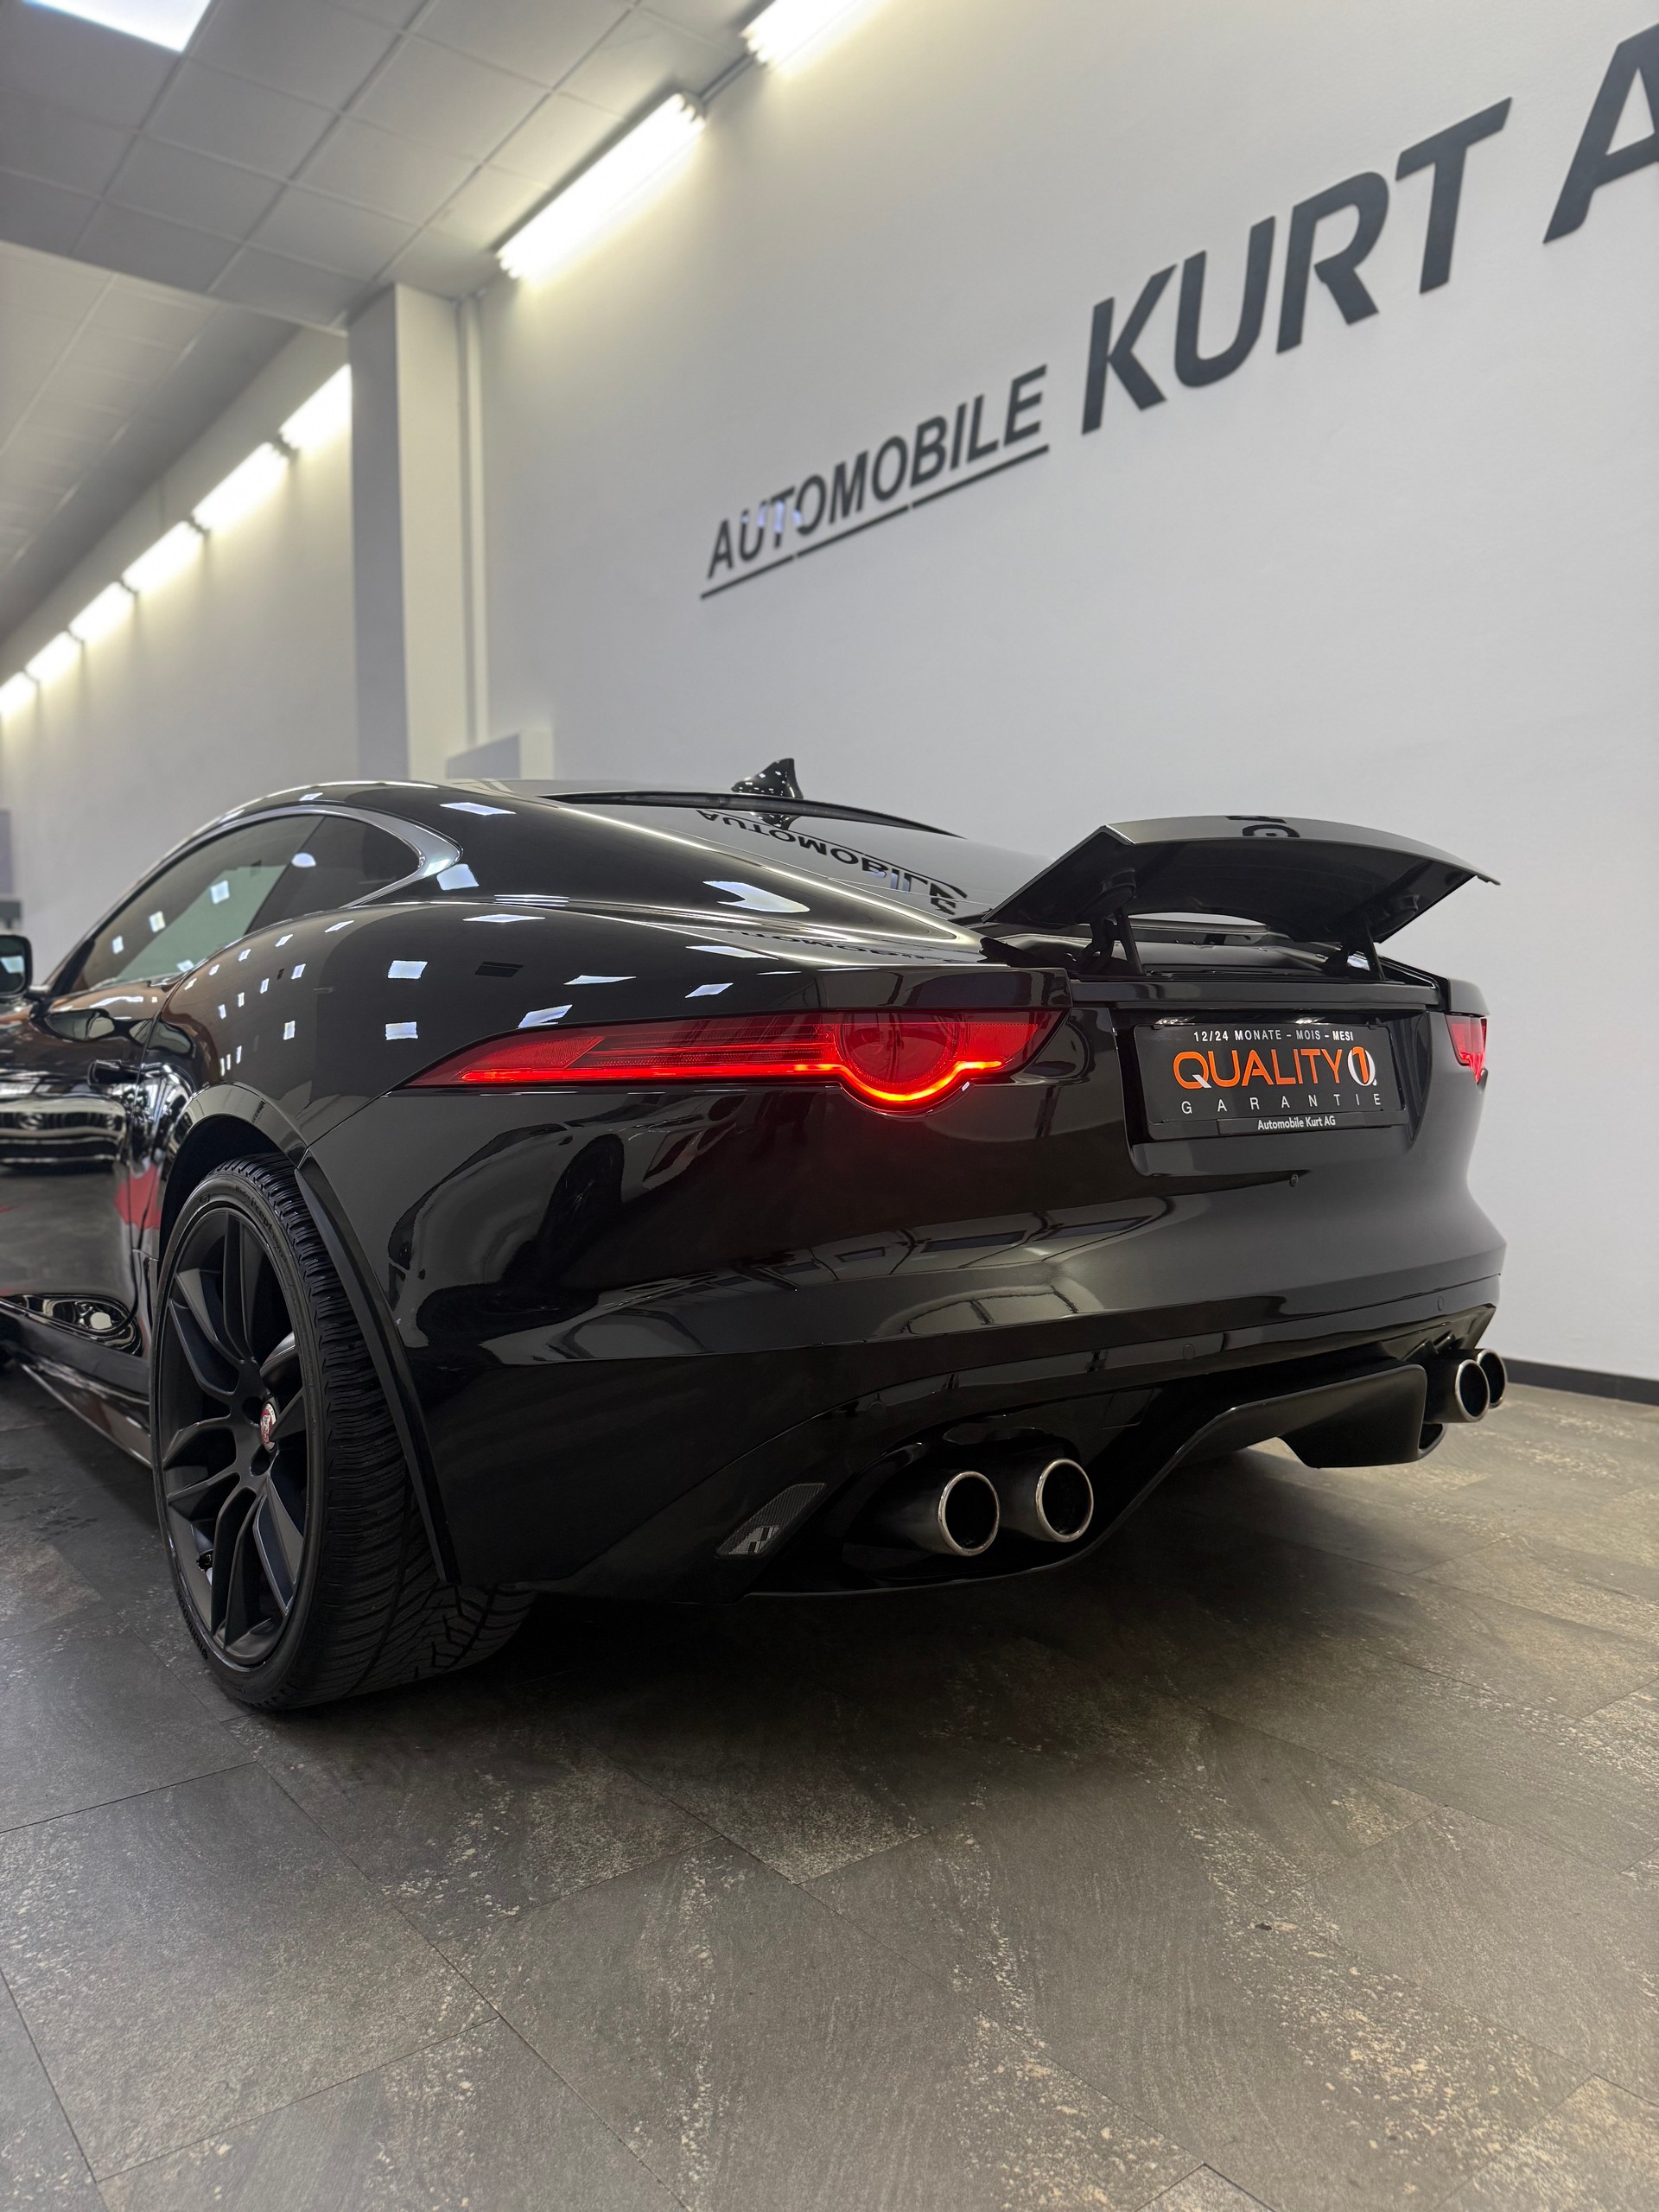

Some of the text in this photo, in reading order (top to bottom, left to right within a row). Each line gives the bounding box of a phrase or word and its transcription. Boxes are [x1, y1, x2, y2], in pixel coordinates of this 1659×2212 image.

[707, 364, 1046, 580] AUTOMOBILE
[1082, 97, 1512, 435] KURT
[1193, 1030, 1230, 1042] 12/24
[1234, 1029, 1282, 1041] MONATE
[1295, 1029, 1321, 1040] MOIS
[1332, 1030, 1354, 1042] MESI
[1181, 1093, 1382, 1115] GARANTIE
[1257, 1115, 1336, 1130] Automobile Kurt AG
